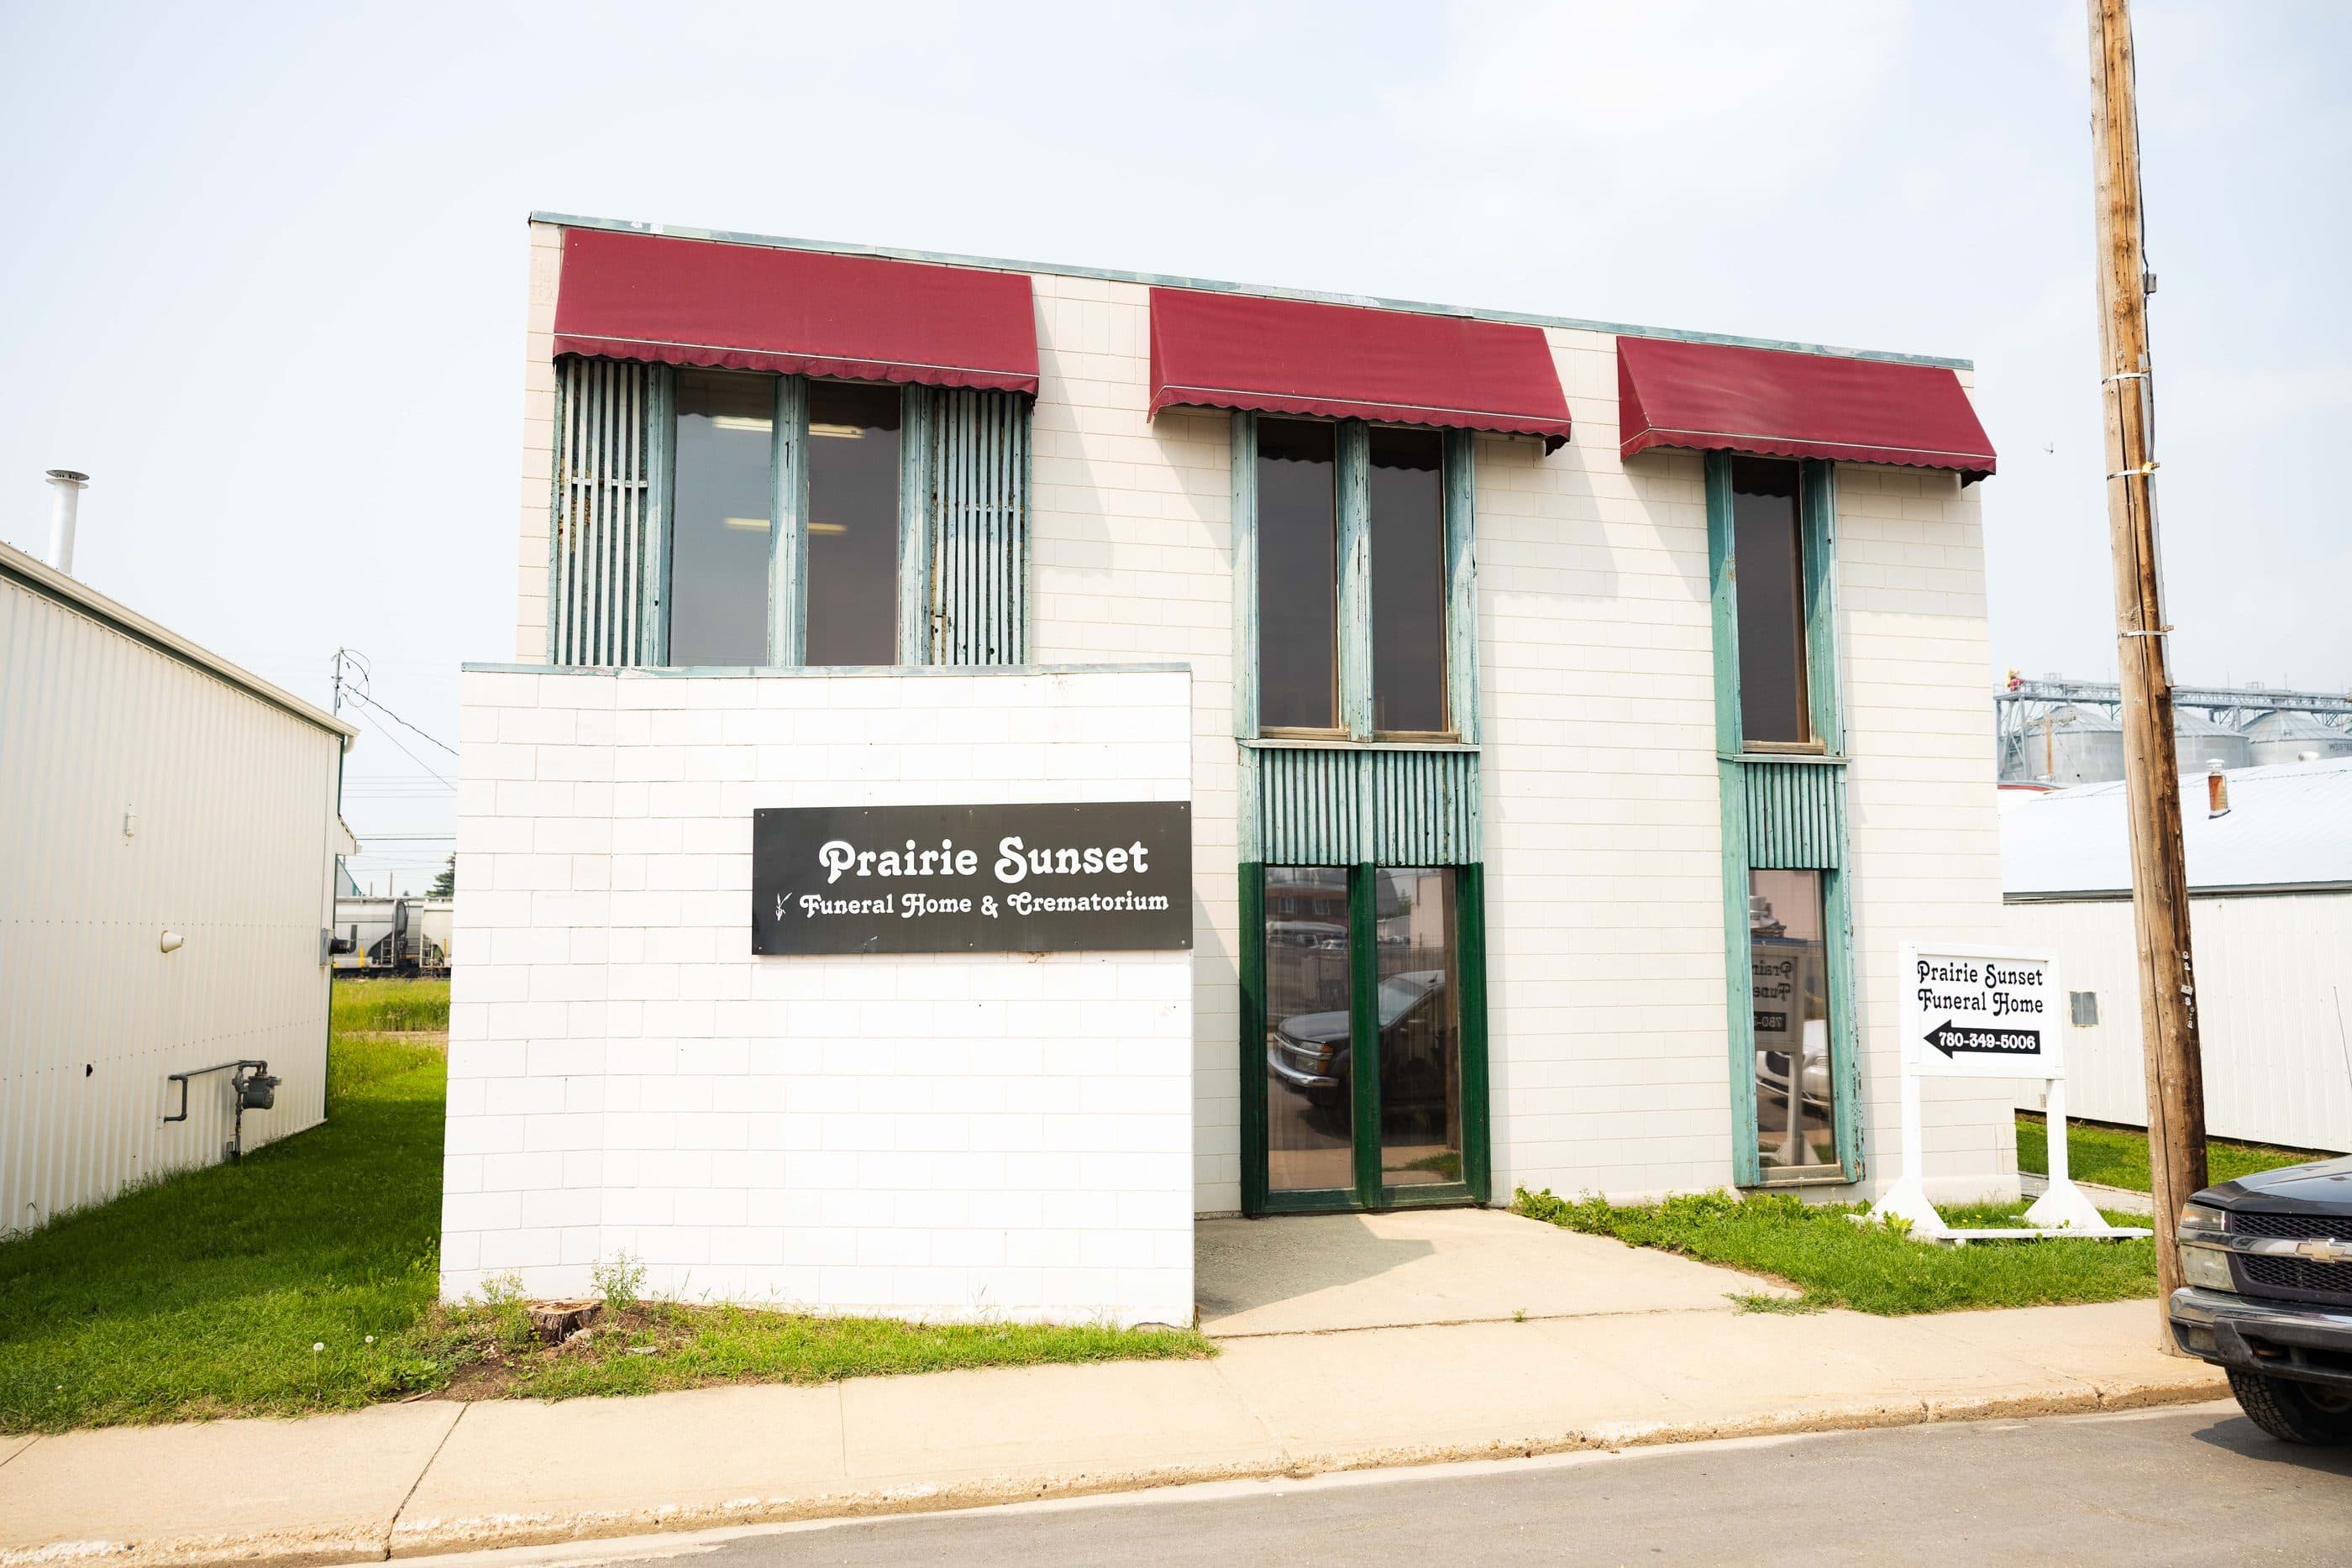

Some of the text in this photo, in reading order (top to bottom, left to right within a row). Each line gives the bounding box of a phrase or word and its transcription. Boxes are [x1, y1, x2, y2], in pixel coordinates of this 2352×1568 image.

[818, 836, 1149, 884] Prairie Sunset
[799, 890, 1169, 919] Funeral Home & Crematorium
[1917, 960, 2043, 989] Prairie Sunset
[1917, 988, 2044, 1017] Funeral Home
[1938, 1031, 2036, 1050] 780-349-5006
